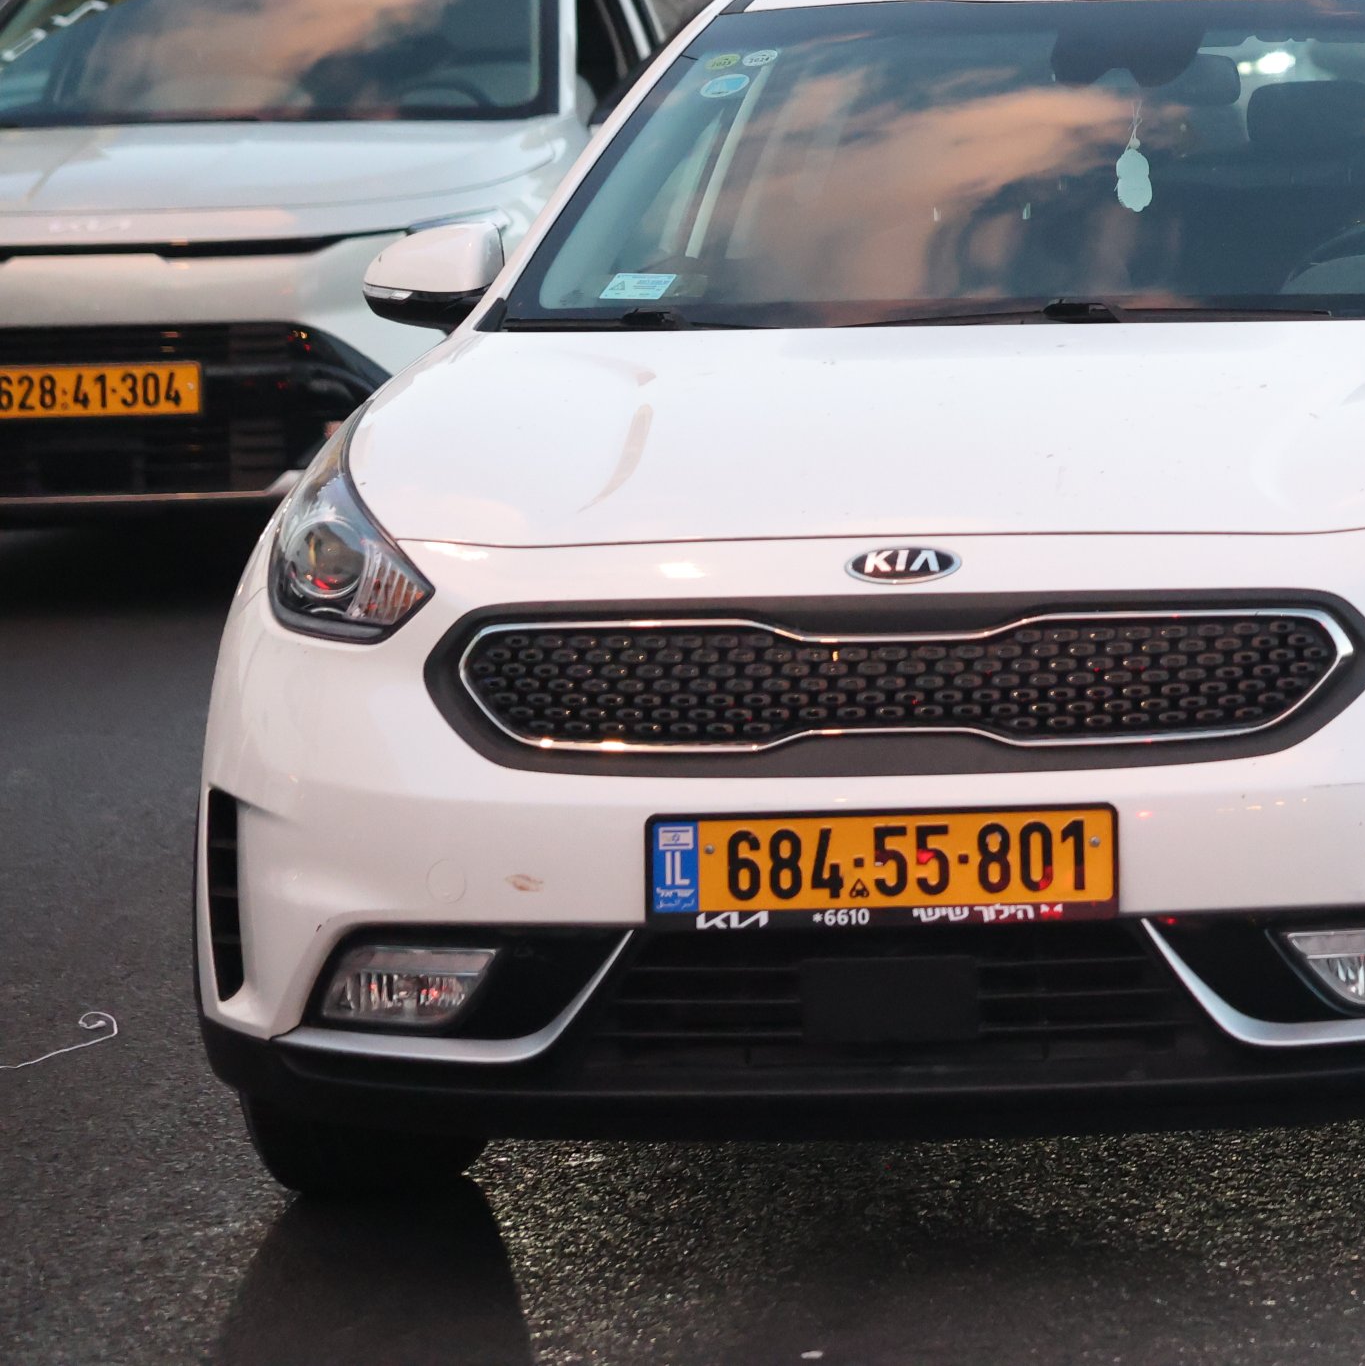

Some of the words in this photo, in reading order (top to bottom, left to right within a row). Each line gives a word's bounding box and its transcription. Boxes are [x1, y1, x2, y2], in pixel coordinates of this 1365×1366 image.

[864, 549, 940, 574] KIA
[664, 851, 690, 886] IL
[696, 911, 769, 930] KIA
[912, 905, 970, 923] שישי
[974, 903, 1035, 923] הילוך
